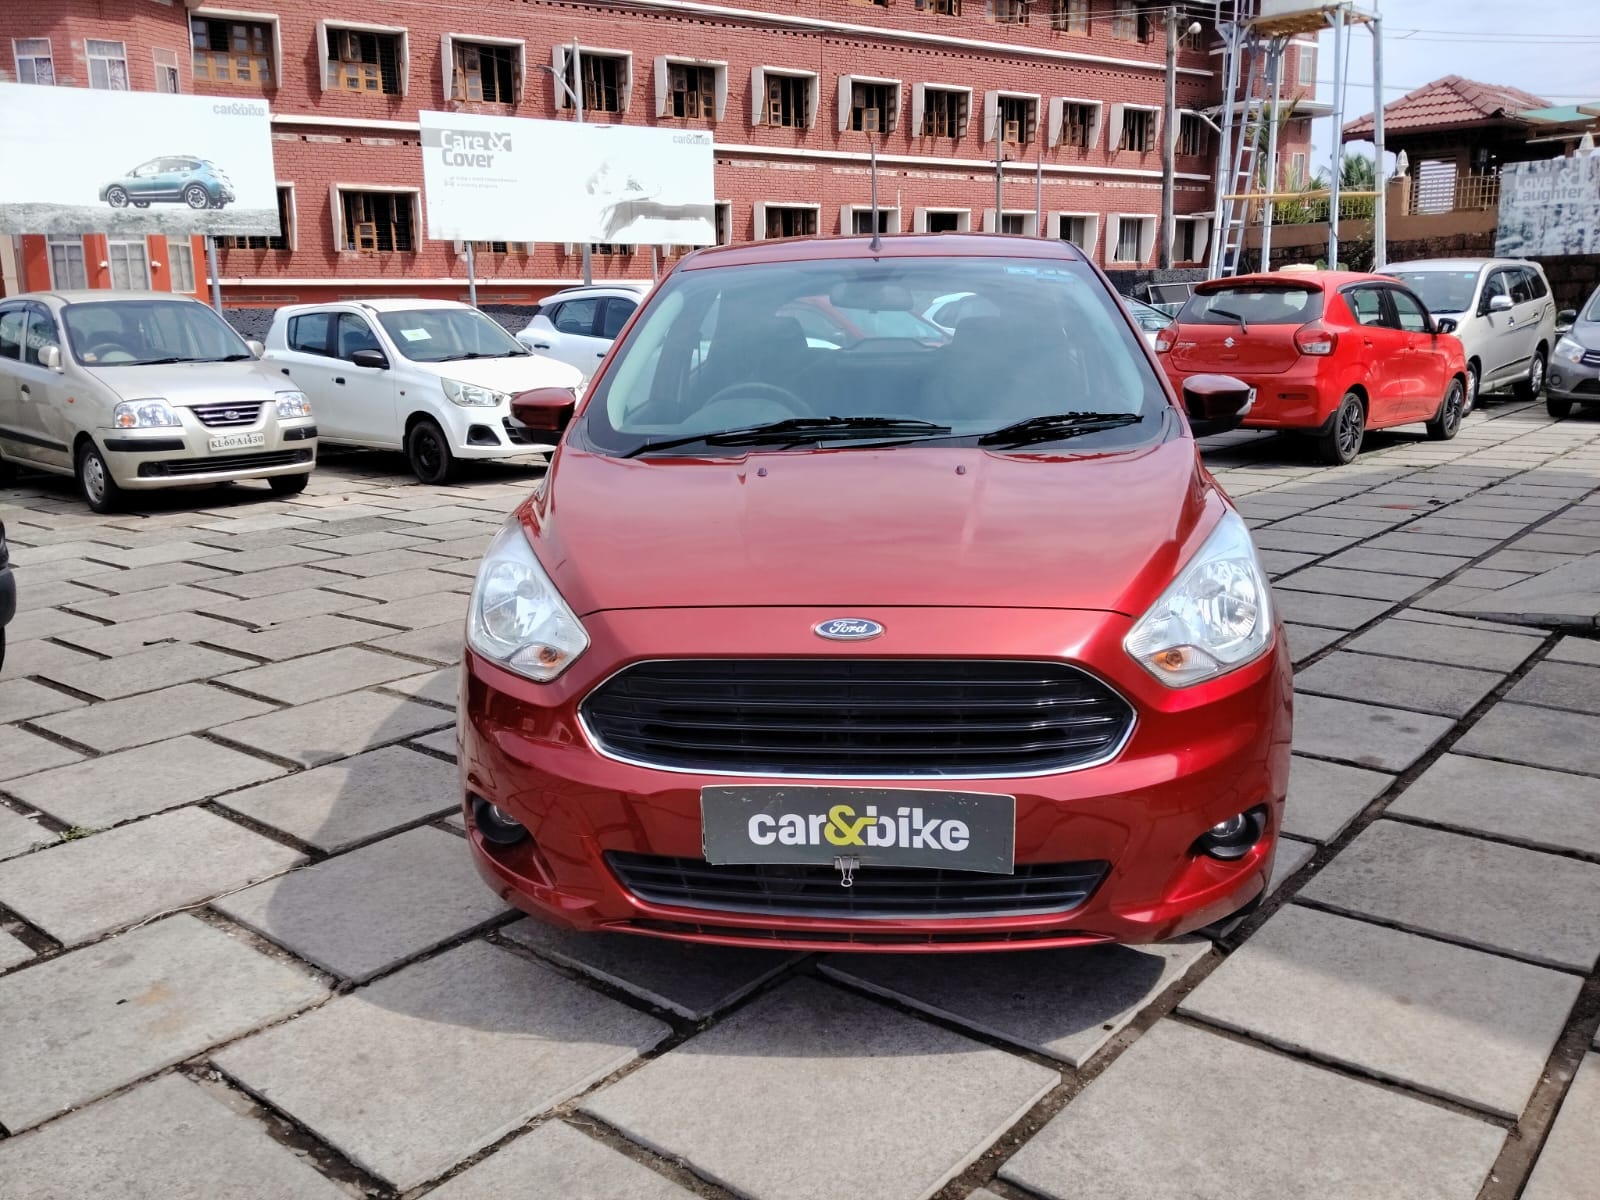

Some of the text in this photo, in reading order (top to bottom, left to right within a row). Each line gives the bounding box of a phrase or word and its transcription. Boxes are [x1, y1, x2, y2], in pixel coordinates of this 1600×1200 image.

[213, 103, 265, 116] car&bike
[441, 130, 511, 152] Care &
[441, 148, 494, 168] Cover
[1515, 174, 1553, 190] Love
[829, 620, 868, 634] Ford
[748, 805, 970, 851] car&bike
